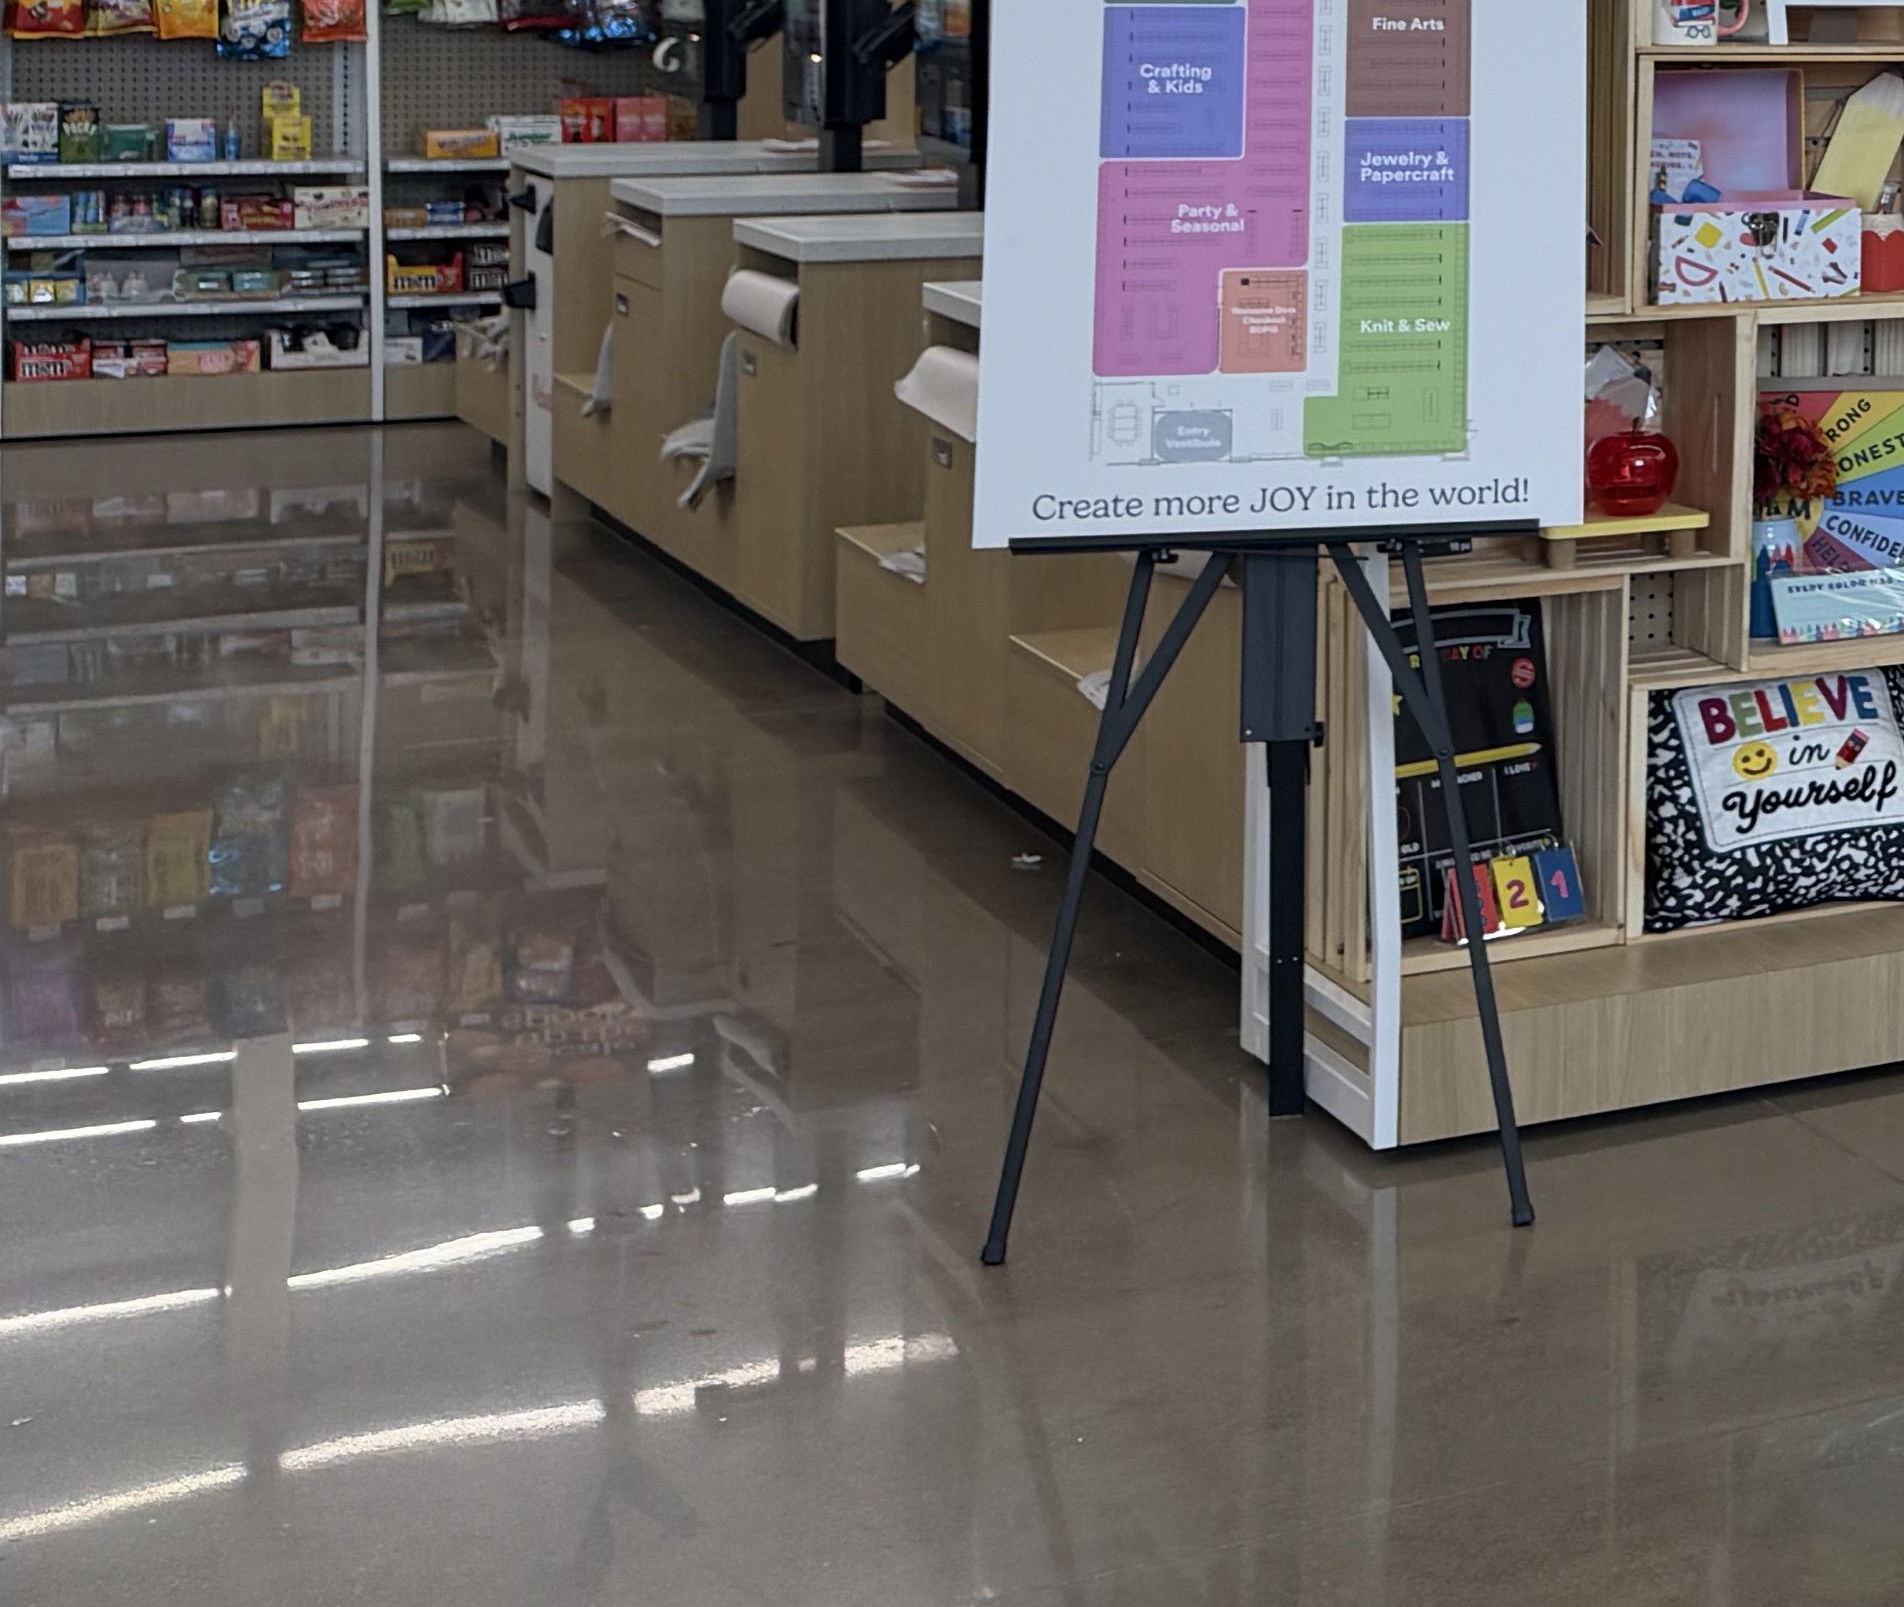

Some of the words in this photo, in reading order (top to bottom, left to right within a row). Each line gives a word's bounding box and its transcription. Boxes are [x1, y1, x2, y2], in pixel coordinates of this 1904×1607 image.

[1372, 16, 1407, 31] Fine
[1410, 16, 1445, 31] Arts
[1139, 63, 1212, 80] Crafting
[1147, 81, 1161, 94] &
[1165, 79, 1203, 94] Kids
[1360, 151, 1432, 168] Jewelry
[1435, 152, 1449, 165] &
[1360, 167, 1454, 184] Papercraft
[1178, 204, 1222, 221] Party
[1225, 204, 1239, 218] &
[1170, 218, 1244, 234] Seasonal
[1360, 319, 1395, 333] Knit
[1398, 319, 1411, 333] &
[1414, 318, 1451, 333] Sew
[1825, 397, 1873, 443] RONG
[1032, 494, 1144, 521] Create
[1153, 494, 1240, 517] more
[1249, 486, 1317, 514] JOY
[1325, 485, 1356, 510] in
[1365, 482, 1419, 508] the
[1428, 478, 1530, 505] world!
[1697, 674, 1879, 746] BELIEVE
[1789, 734, 1831, 765] in
[1550, 869, 1569, 899] 1
[1506, 877, 1529, 909] 2
